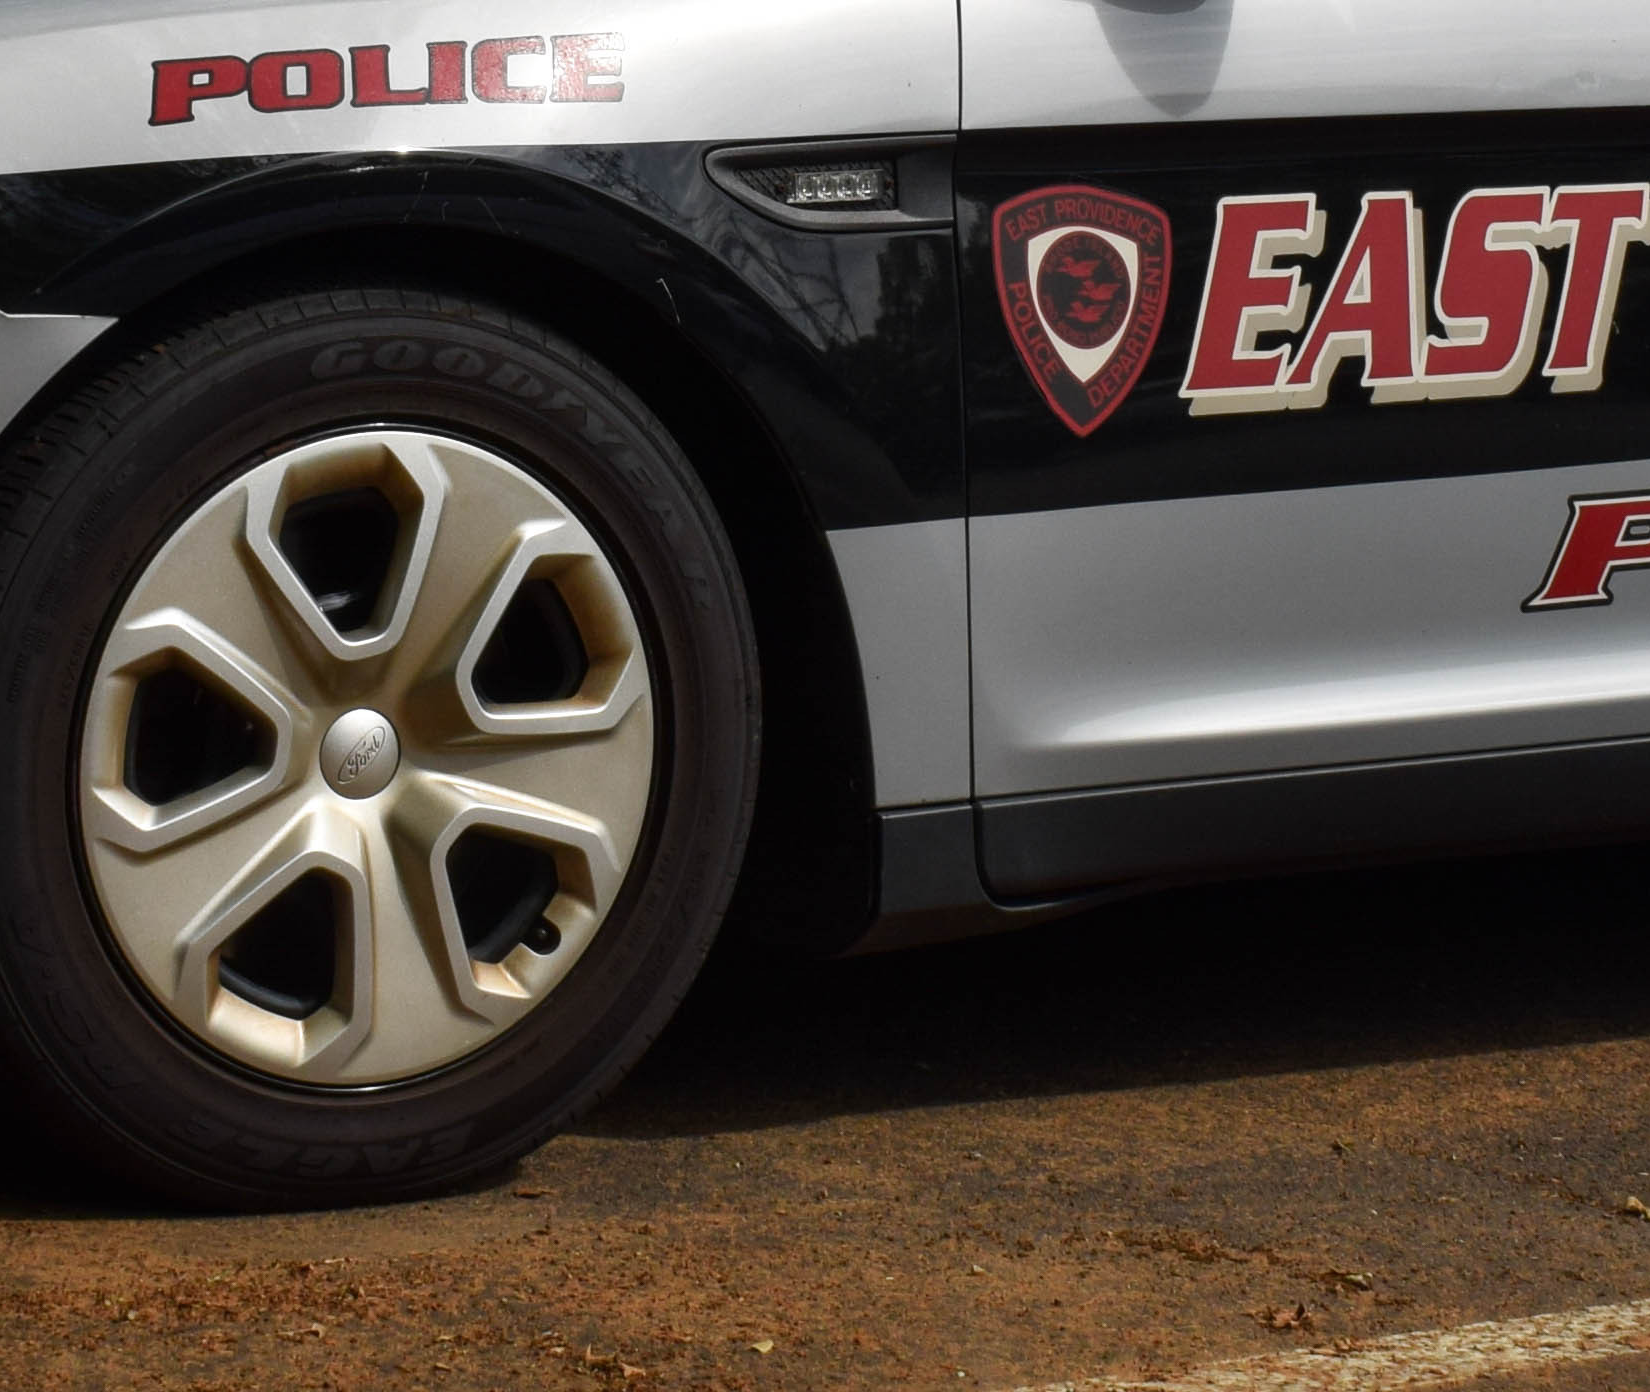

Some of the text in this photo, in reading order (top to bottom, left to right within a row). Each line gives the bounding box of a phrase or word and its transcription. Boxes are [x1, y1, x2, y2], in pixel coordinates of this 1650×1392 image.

[148, 31, 625, 126] POLICE
[1005, 198, 1162, 247] EAST PROVIDENCE
[1006, 282, 1063, 383] POLICE
[1086, 254, 1162, 410] DEPARTMENT
[311, 337, 710, 610] GOODYEAR
